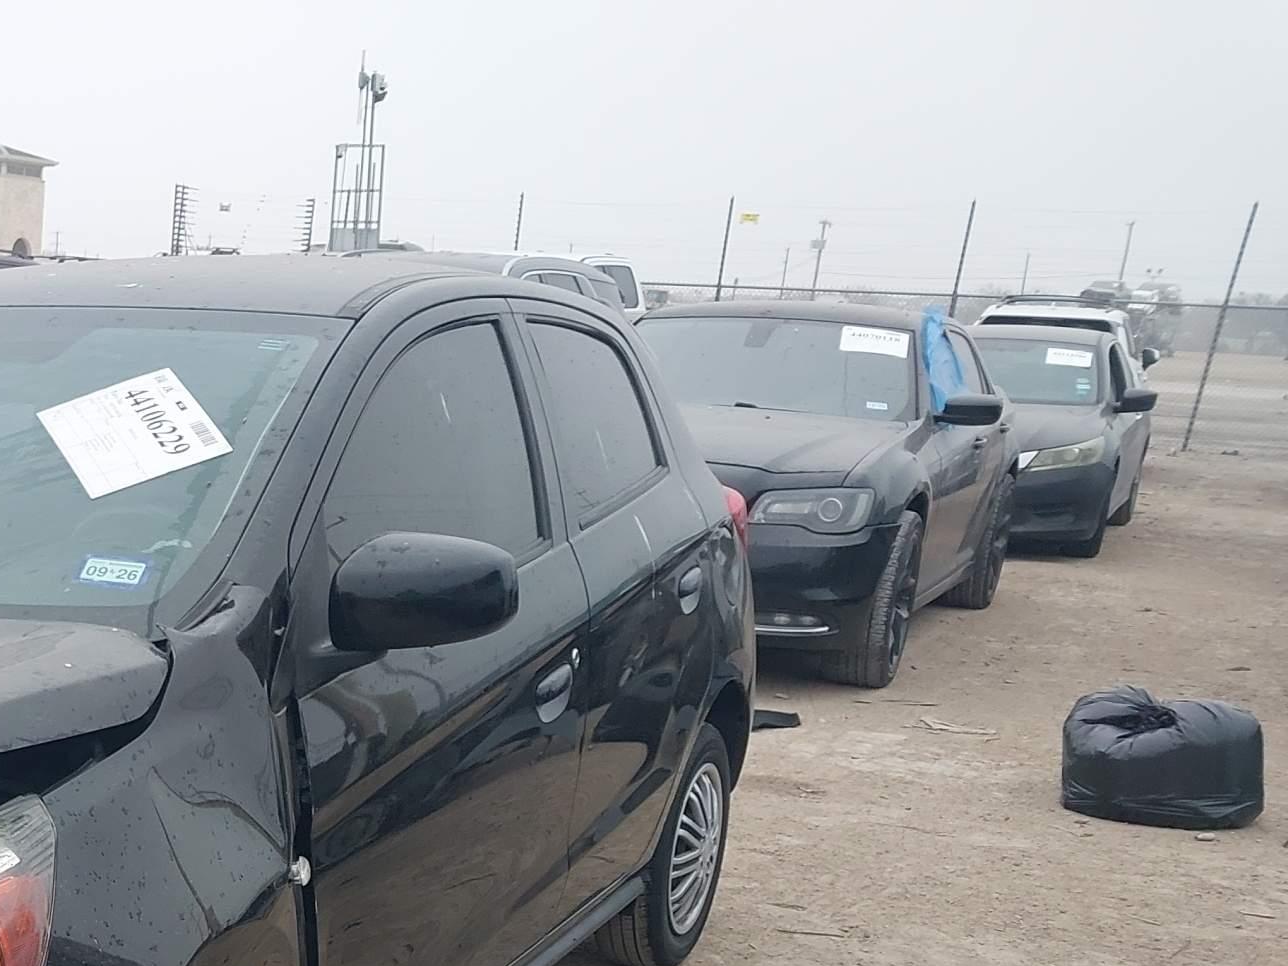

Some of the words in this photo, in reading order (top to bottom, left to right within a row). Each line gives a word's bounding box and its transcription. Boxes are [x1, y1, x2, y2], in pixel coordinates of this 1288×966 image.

[125, 390, 191, 455] 44106229
[85, 565, 108, 577] 09
[115, 568, 139, 581] 26
